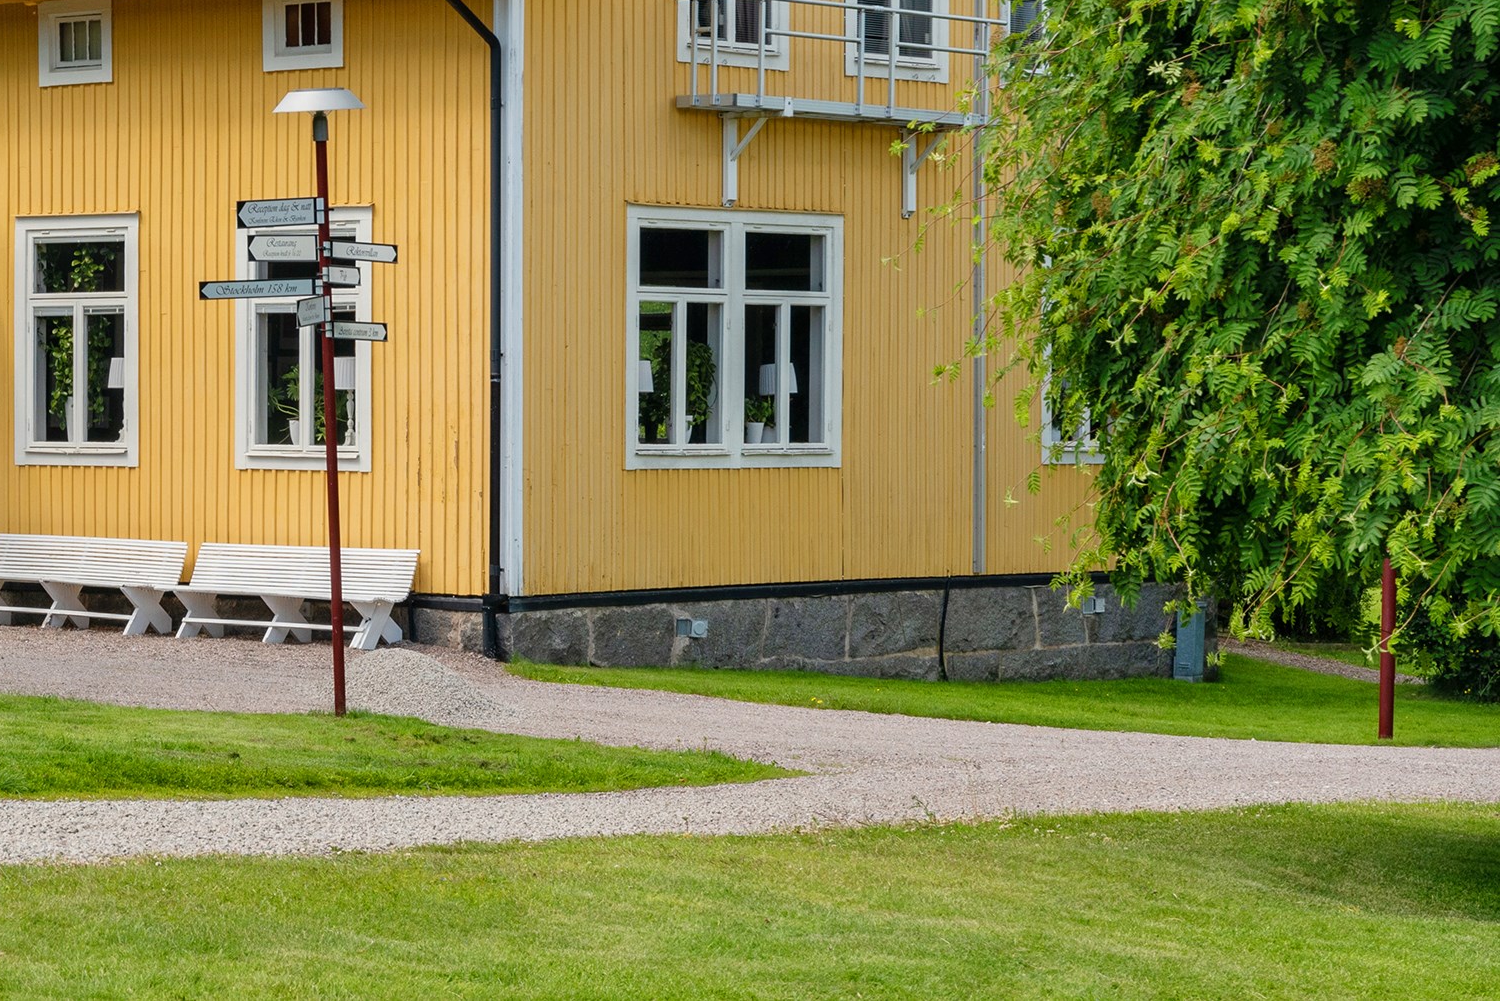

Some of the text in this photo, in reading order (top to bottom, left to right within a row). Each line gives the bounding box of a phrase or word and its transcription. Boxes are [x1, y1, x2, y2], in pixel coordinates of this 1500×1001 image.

[247, 201, 312, 216] Reception dag & natt
[266, 237, 298, 250] Restaurang
[215, 284, 298, 296] Stockholm 158 km
